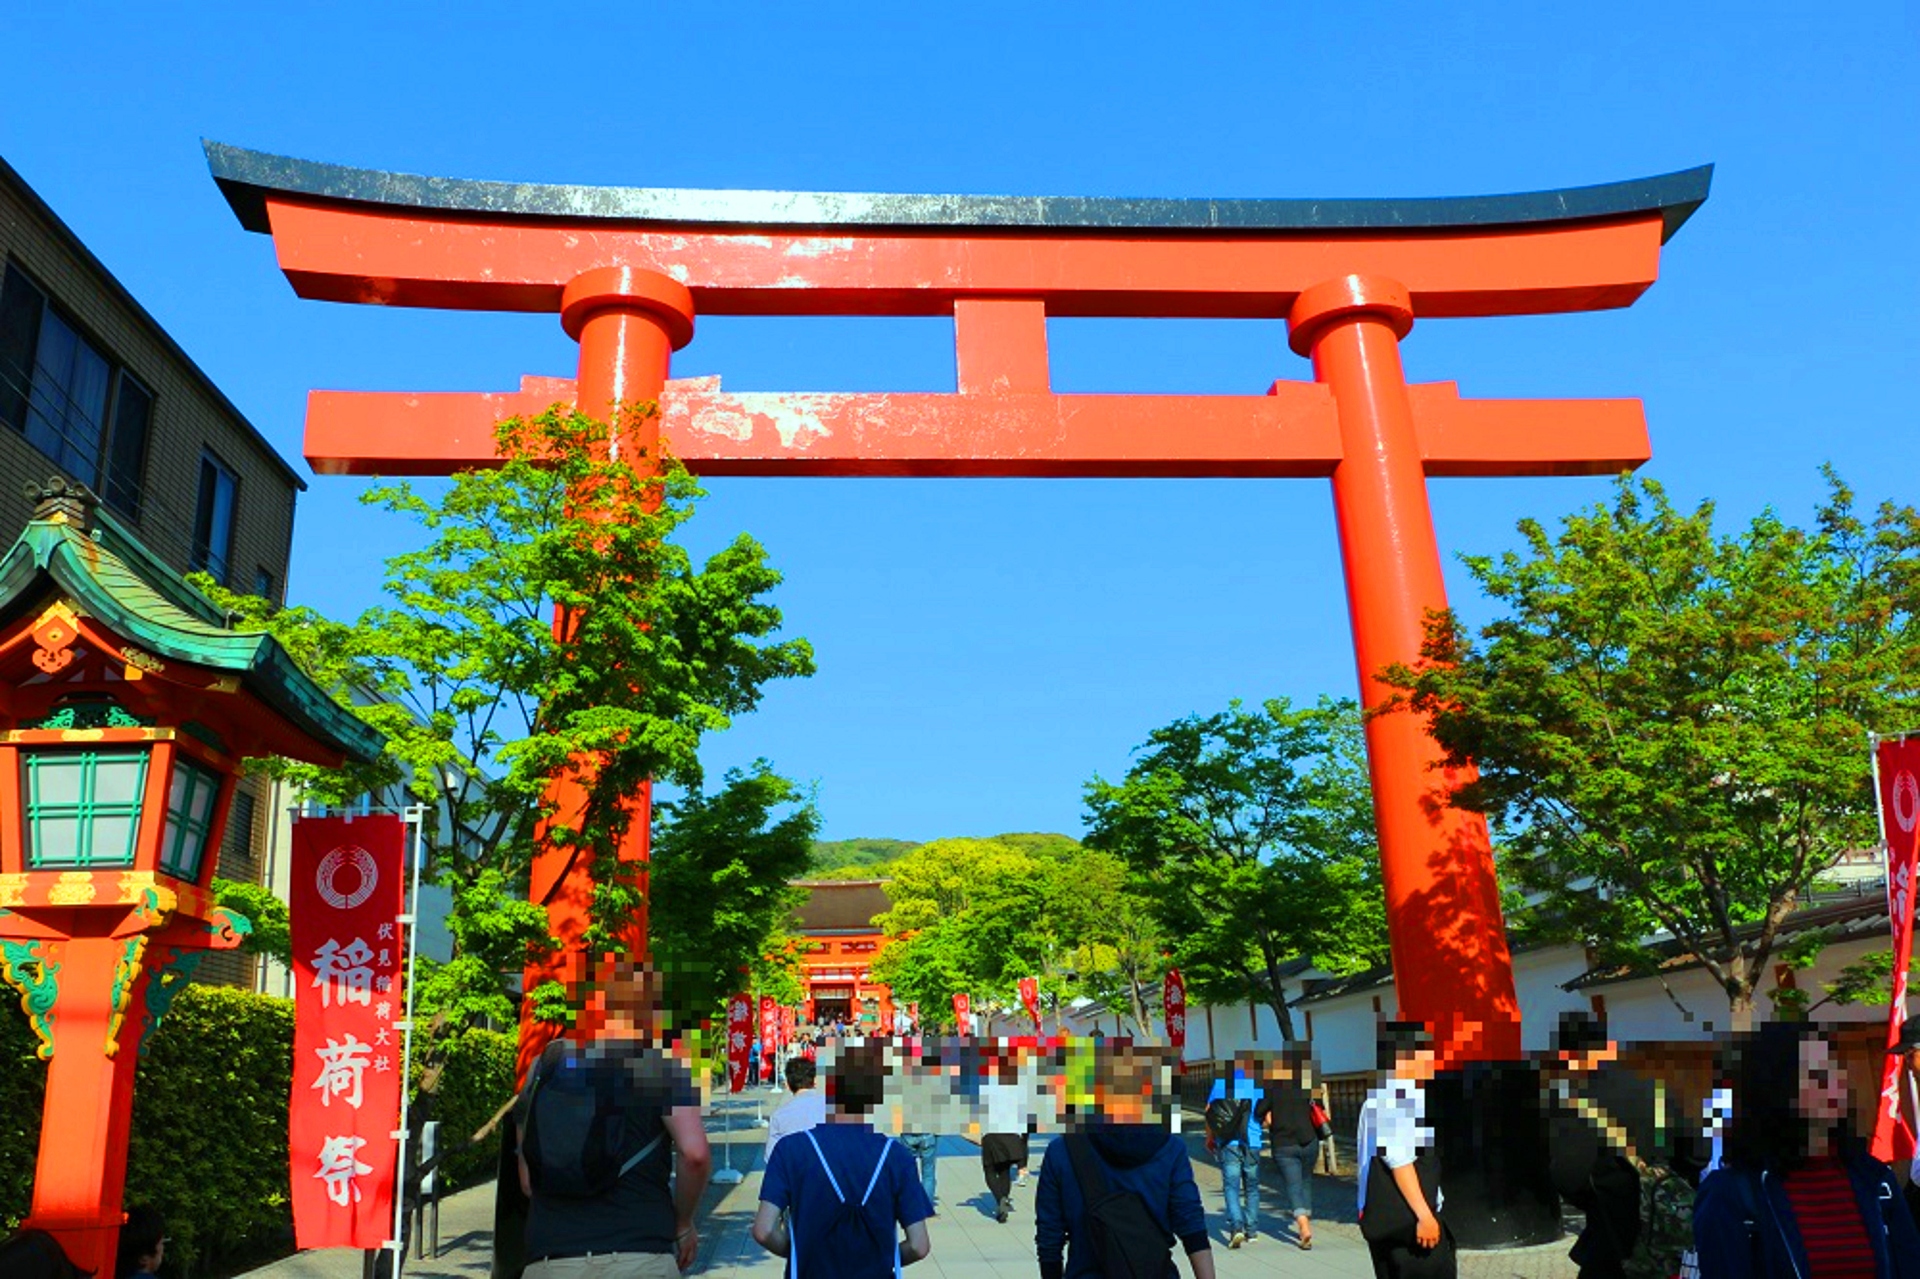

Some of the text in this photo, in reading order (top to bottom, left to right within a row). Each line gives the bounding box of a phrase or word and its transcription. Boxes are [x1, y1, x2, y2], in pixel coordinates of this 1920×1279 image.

[310, 937, 375, 1208] 稲荷祭
[374, 922, 394, 1073] 伏見稲荷大社
